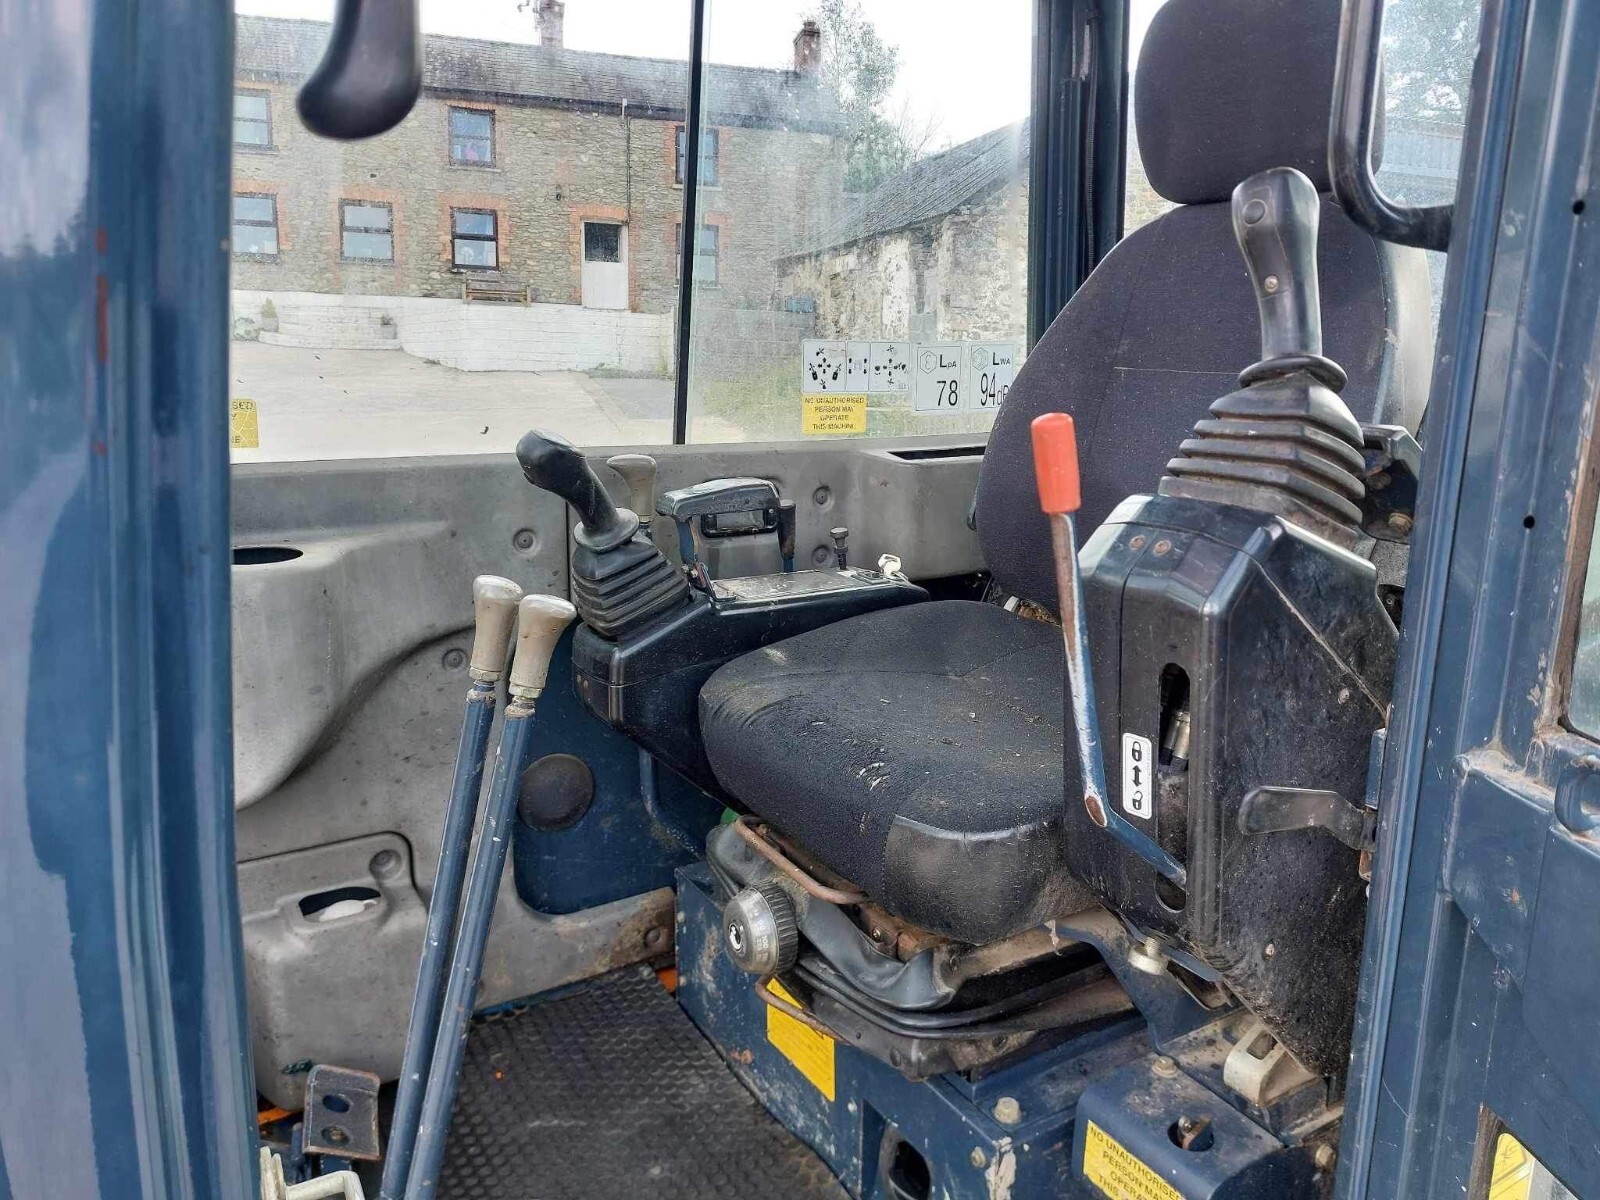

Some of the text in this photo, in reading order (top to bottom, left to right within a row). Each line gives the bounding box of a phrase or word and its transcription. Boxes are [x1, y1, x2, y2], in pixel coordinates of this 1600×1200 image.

[936, 380, 958, 406] 78
[1090, 1126, 1104, 1142] NO
[1103, 1151, 1143, 1188] PERSON
[1099, 1173, 1119, 1197] THIS
